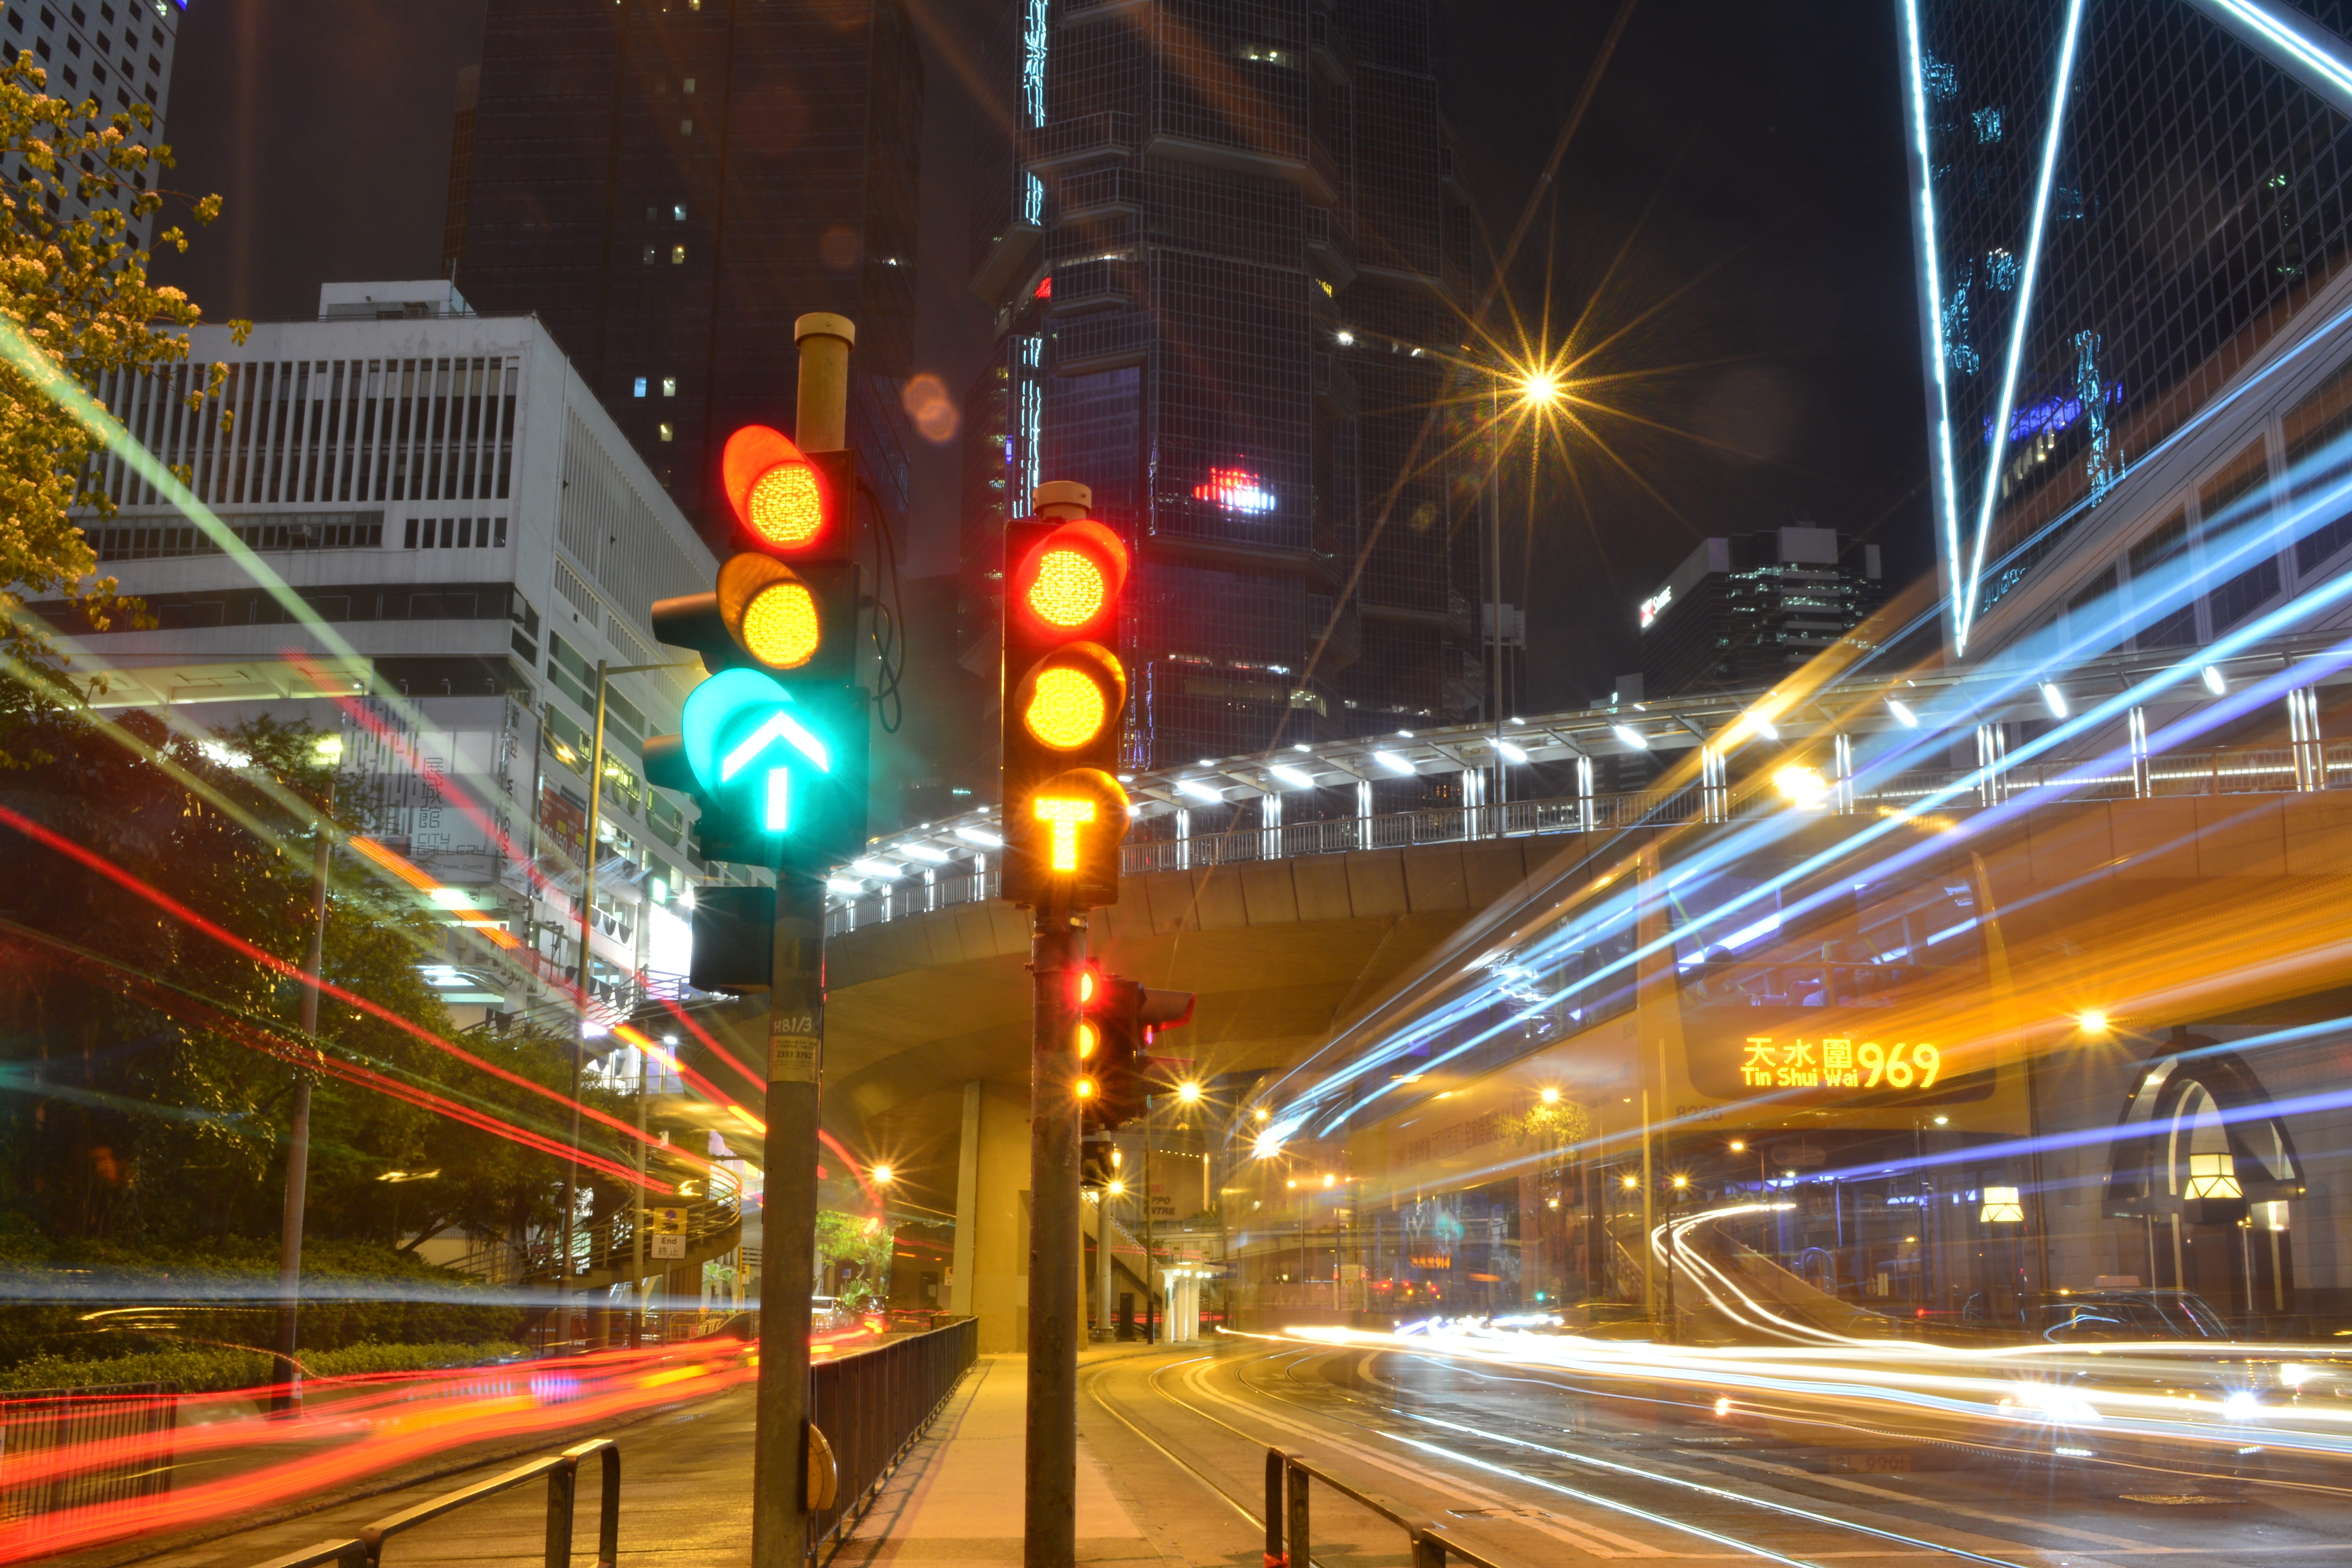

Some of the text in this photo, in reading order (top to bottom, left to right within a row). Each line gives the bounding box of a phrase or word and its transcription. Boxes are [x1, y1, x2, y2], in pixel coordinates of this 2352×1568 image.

[418, 833, 450, 844] CITY
[417, 845, 486, 855] GALLERY
[774, 1016, 811, 1033] H81/3
[1744, 1038, 1852, 1069] 天水圍
[1858, 1042, 1940, 1088] 969
[1740, 1067, 1858, 1087] Tin Shui Wai
[658, 1247, 678, 1256] 終止
